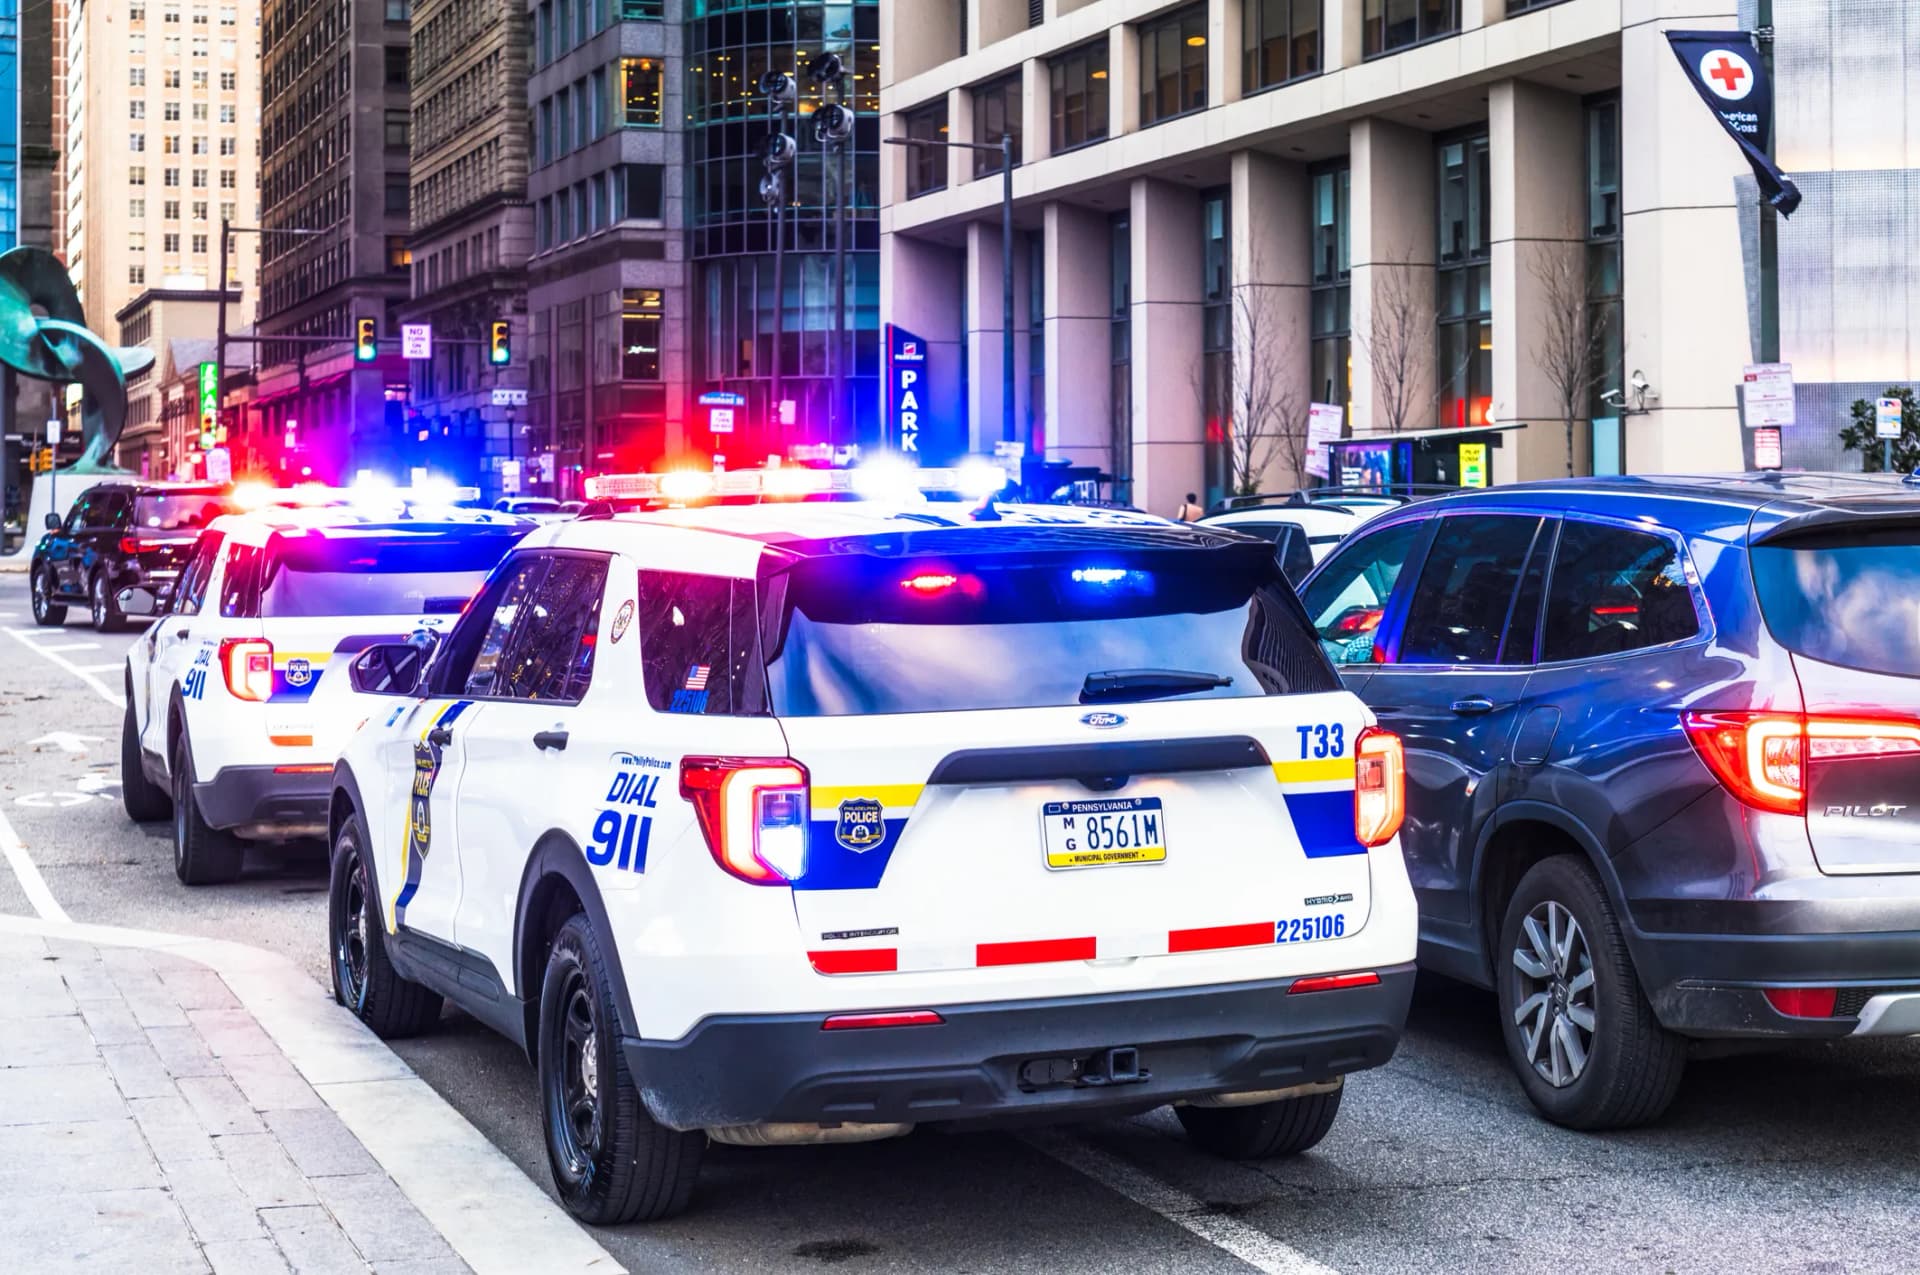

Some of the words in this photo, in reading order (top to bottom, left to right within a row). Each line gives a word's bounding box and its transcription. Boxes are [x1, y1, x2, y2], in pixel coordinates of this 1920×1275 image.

[901, 370, 919, 452] PARK
[182, 668, 207, 700] 911
[1296, 722, 1344, 760] T33
[606, 771, 660, 808] DIAL
[844, 811, 878, 824] POLICE
[1072, 801, 1133, 813] PENNSYLVANIA
[1823, 803, 1907, 817] PILOT
[1063, 817, 1075, 829] M
[1086, 814, 1159, 850] 8561M
[586, 809, 653, 874] 911
[1066, 838, 1077, 851] G
[1074, 853, 1102, 863] MUNICIPAL
[1103, 851, 1139, 861] GOVERNMENT
[1276, 913, 1345, 943] 225106
